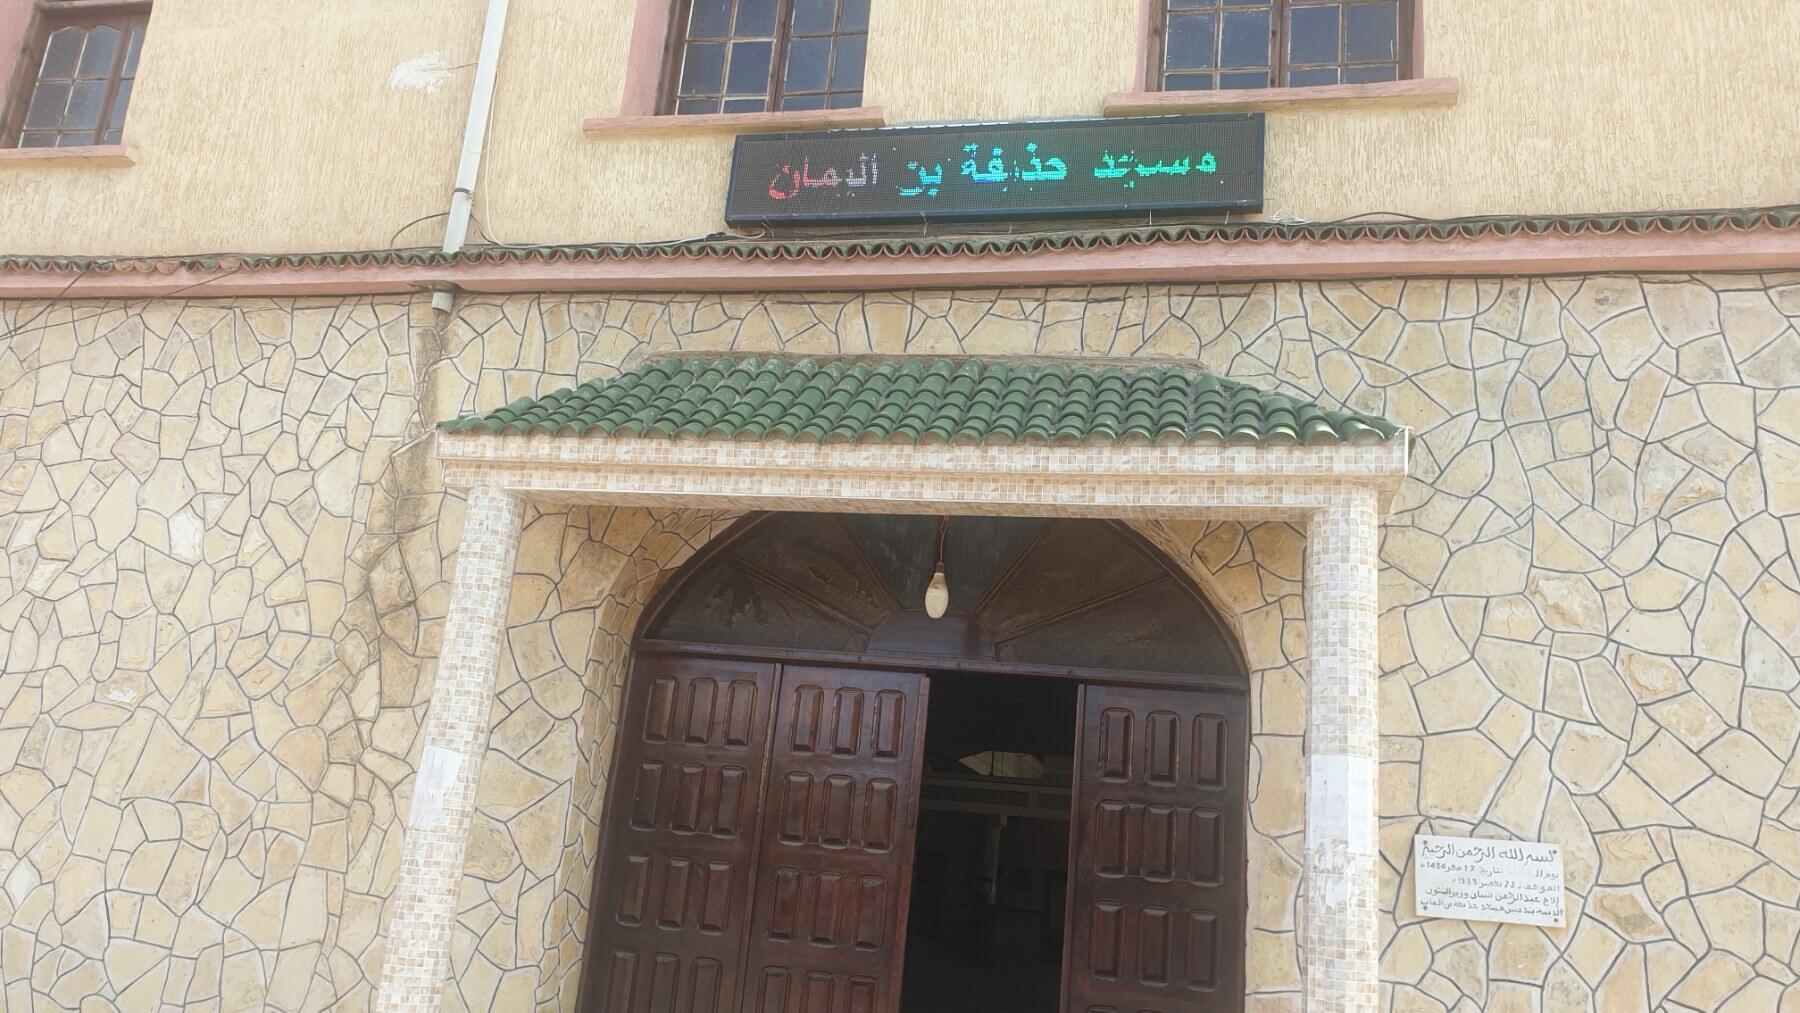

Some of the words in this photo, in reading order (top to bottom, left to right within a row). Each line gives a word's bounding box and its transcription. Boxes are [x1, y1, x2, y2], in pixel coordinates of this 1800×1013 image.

[1421, 843, 1455, 858] الرحيم
[1456, 846, 1495, 863] الرحمن
[1499, 847, 1523, 860] الله
[1524, 849, 1554, 866] بسم
